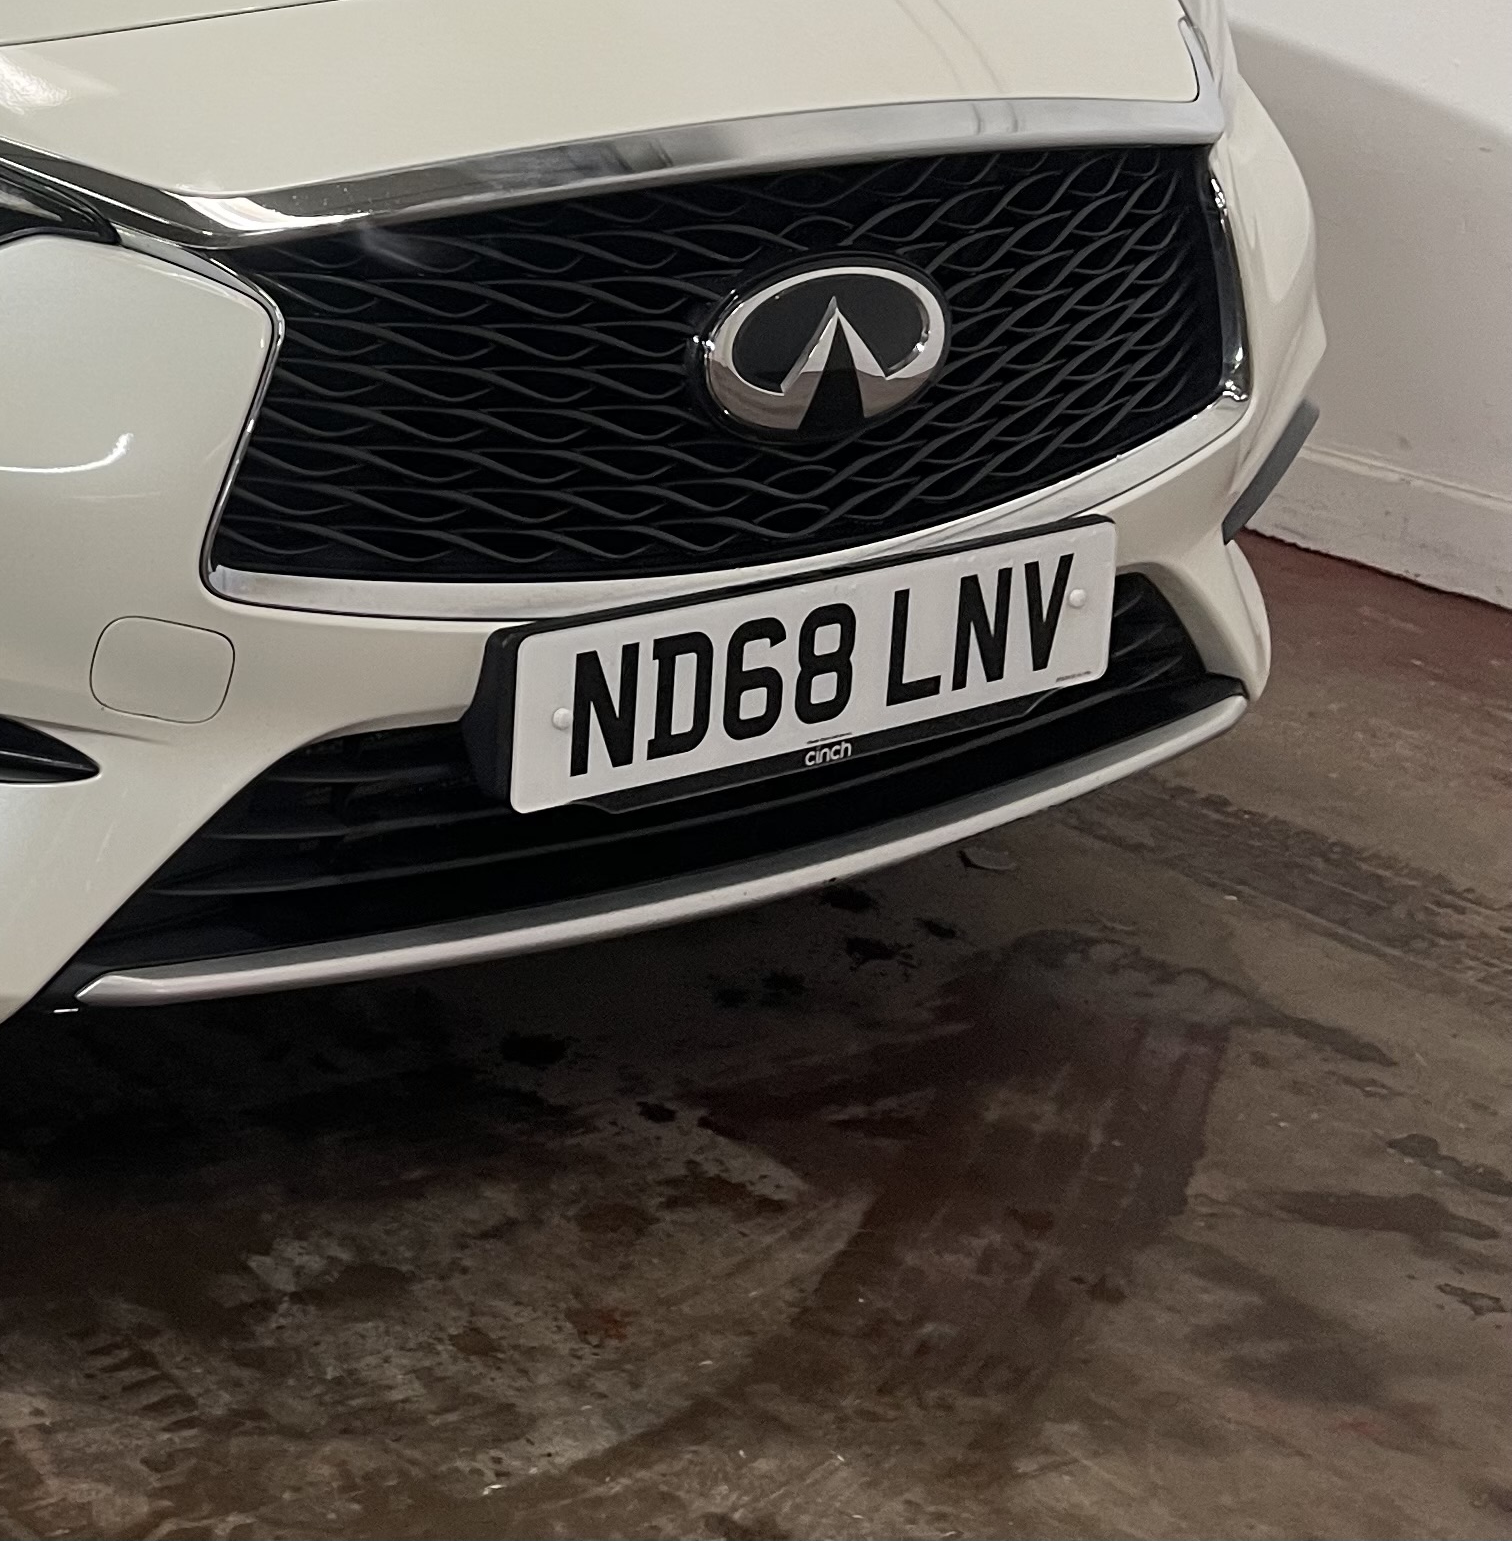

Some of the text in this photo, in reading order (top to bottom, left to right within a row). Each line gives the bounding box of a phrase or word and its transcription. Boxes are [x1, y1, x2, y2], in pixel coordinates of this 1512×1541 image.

[570, 553, 1075, 777] ND68 LNV
[804, 741, 853, 766] cinch
